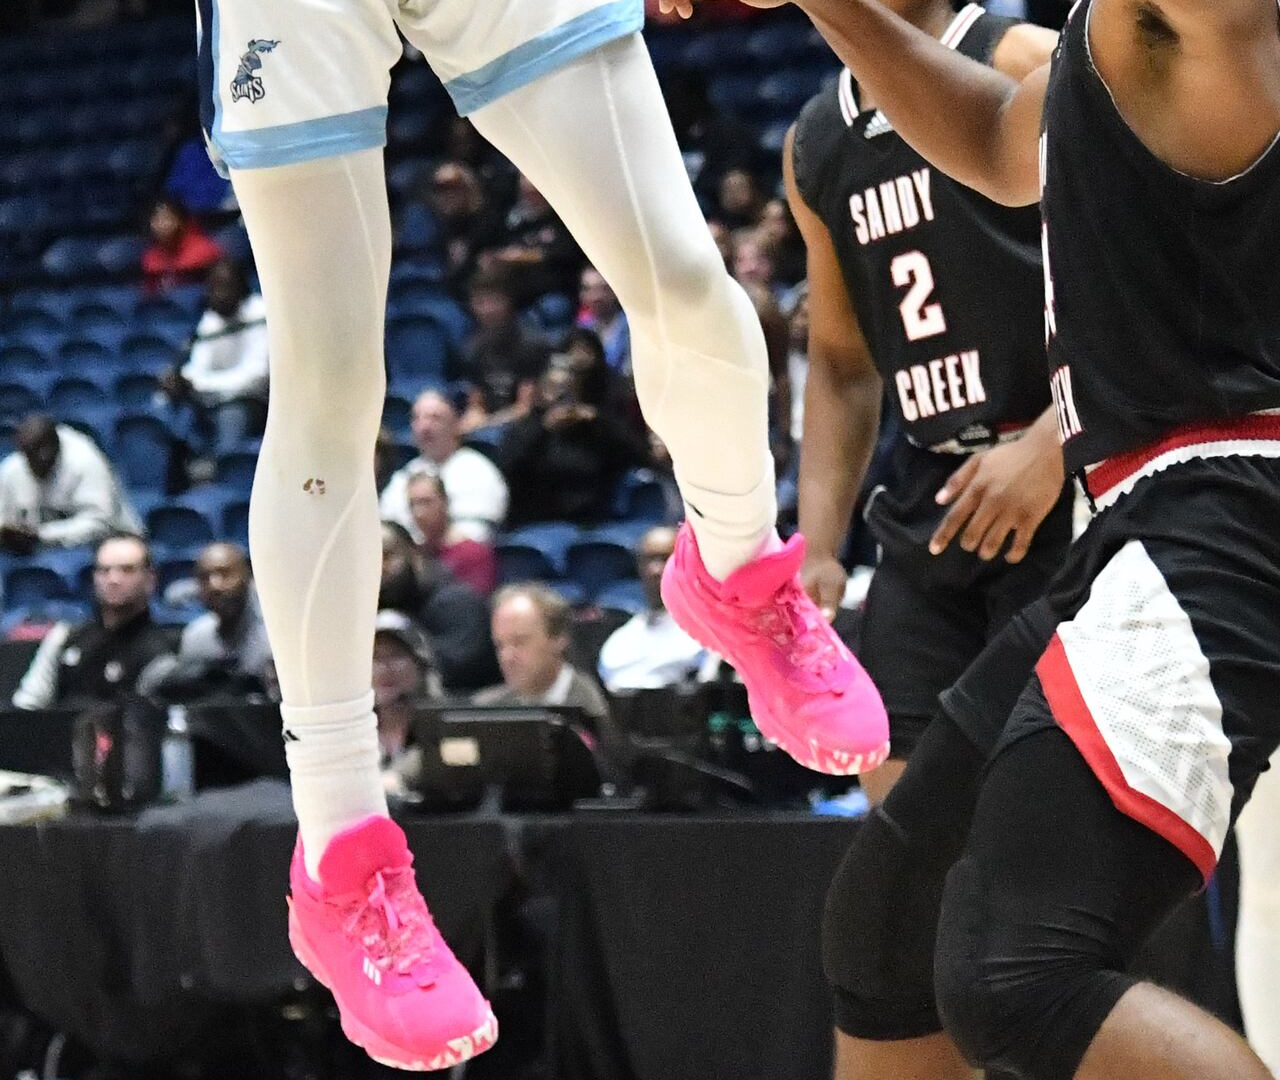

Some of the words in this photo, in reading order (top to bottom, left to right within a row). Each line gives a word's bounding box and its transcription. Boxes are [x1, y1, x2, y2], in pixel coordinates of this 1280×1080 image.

[849, 168, 934, 245] SANDY
[890, 250, 948, 342] 2
[895, 349, 986, 421] CREEK
